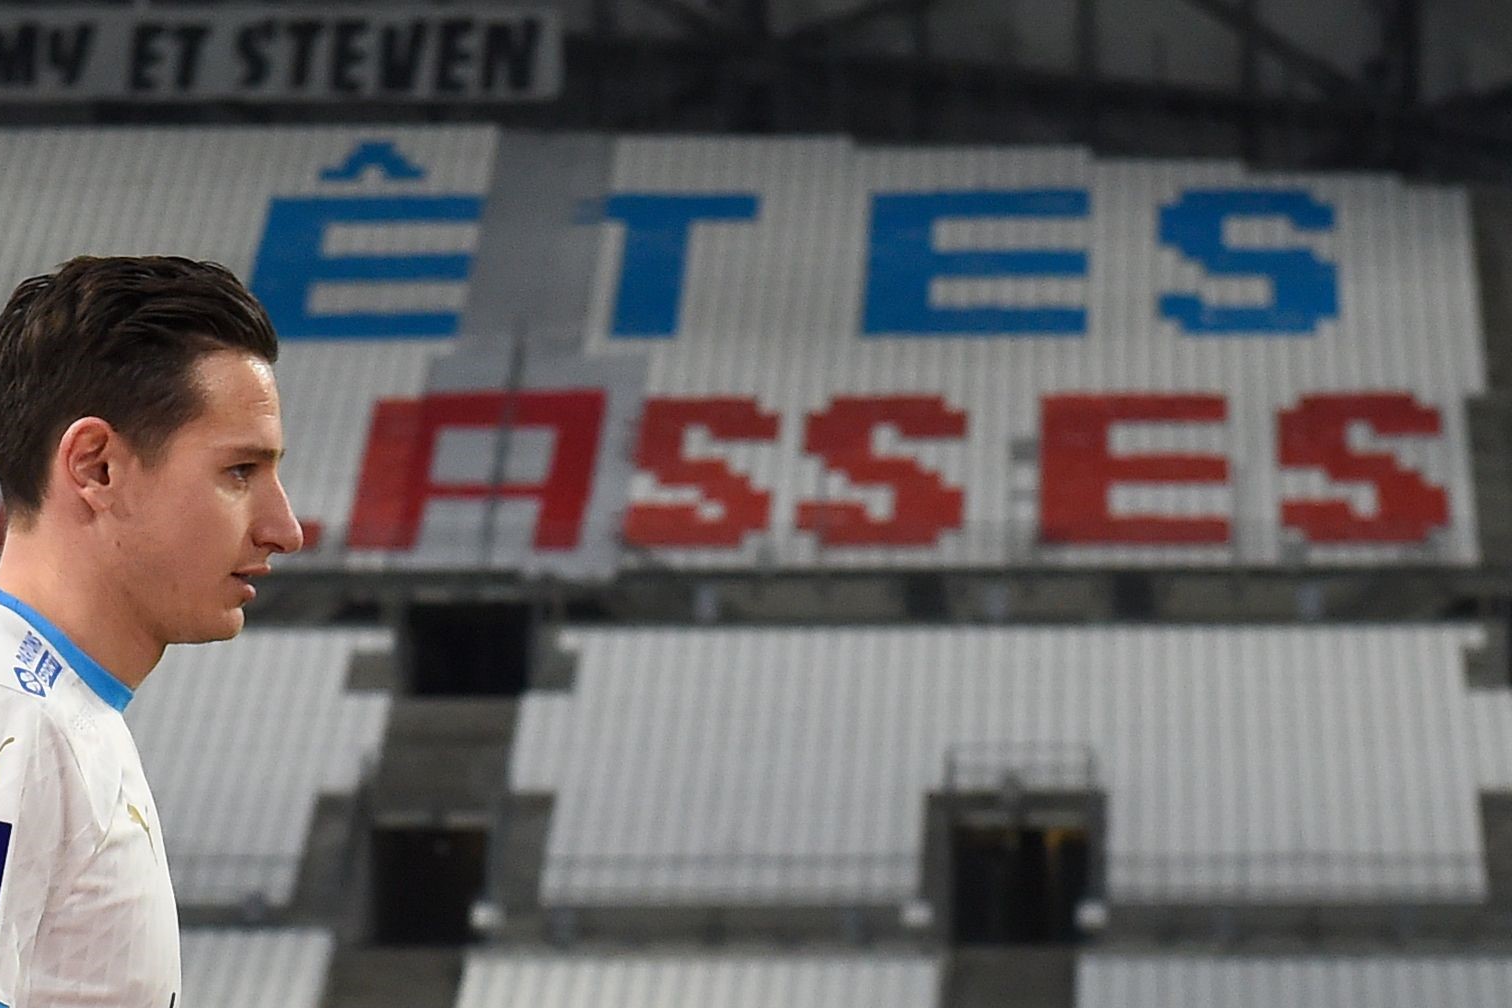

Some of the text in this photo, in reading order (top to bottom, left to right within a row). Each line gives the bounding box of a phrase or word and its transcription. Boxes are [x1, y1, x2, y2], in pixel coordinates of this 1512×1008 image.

[129, 23, 211, 93] ET
[234, 17, 540, 93] STEVEN
[247, 140, 1340, 339] ÊTES
